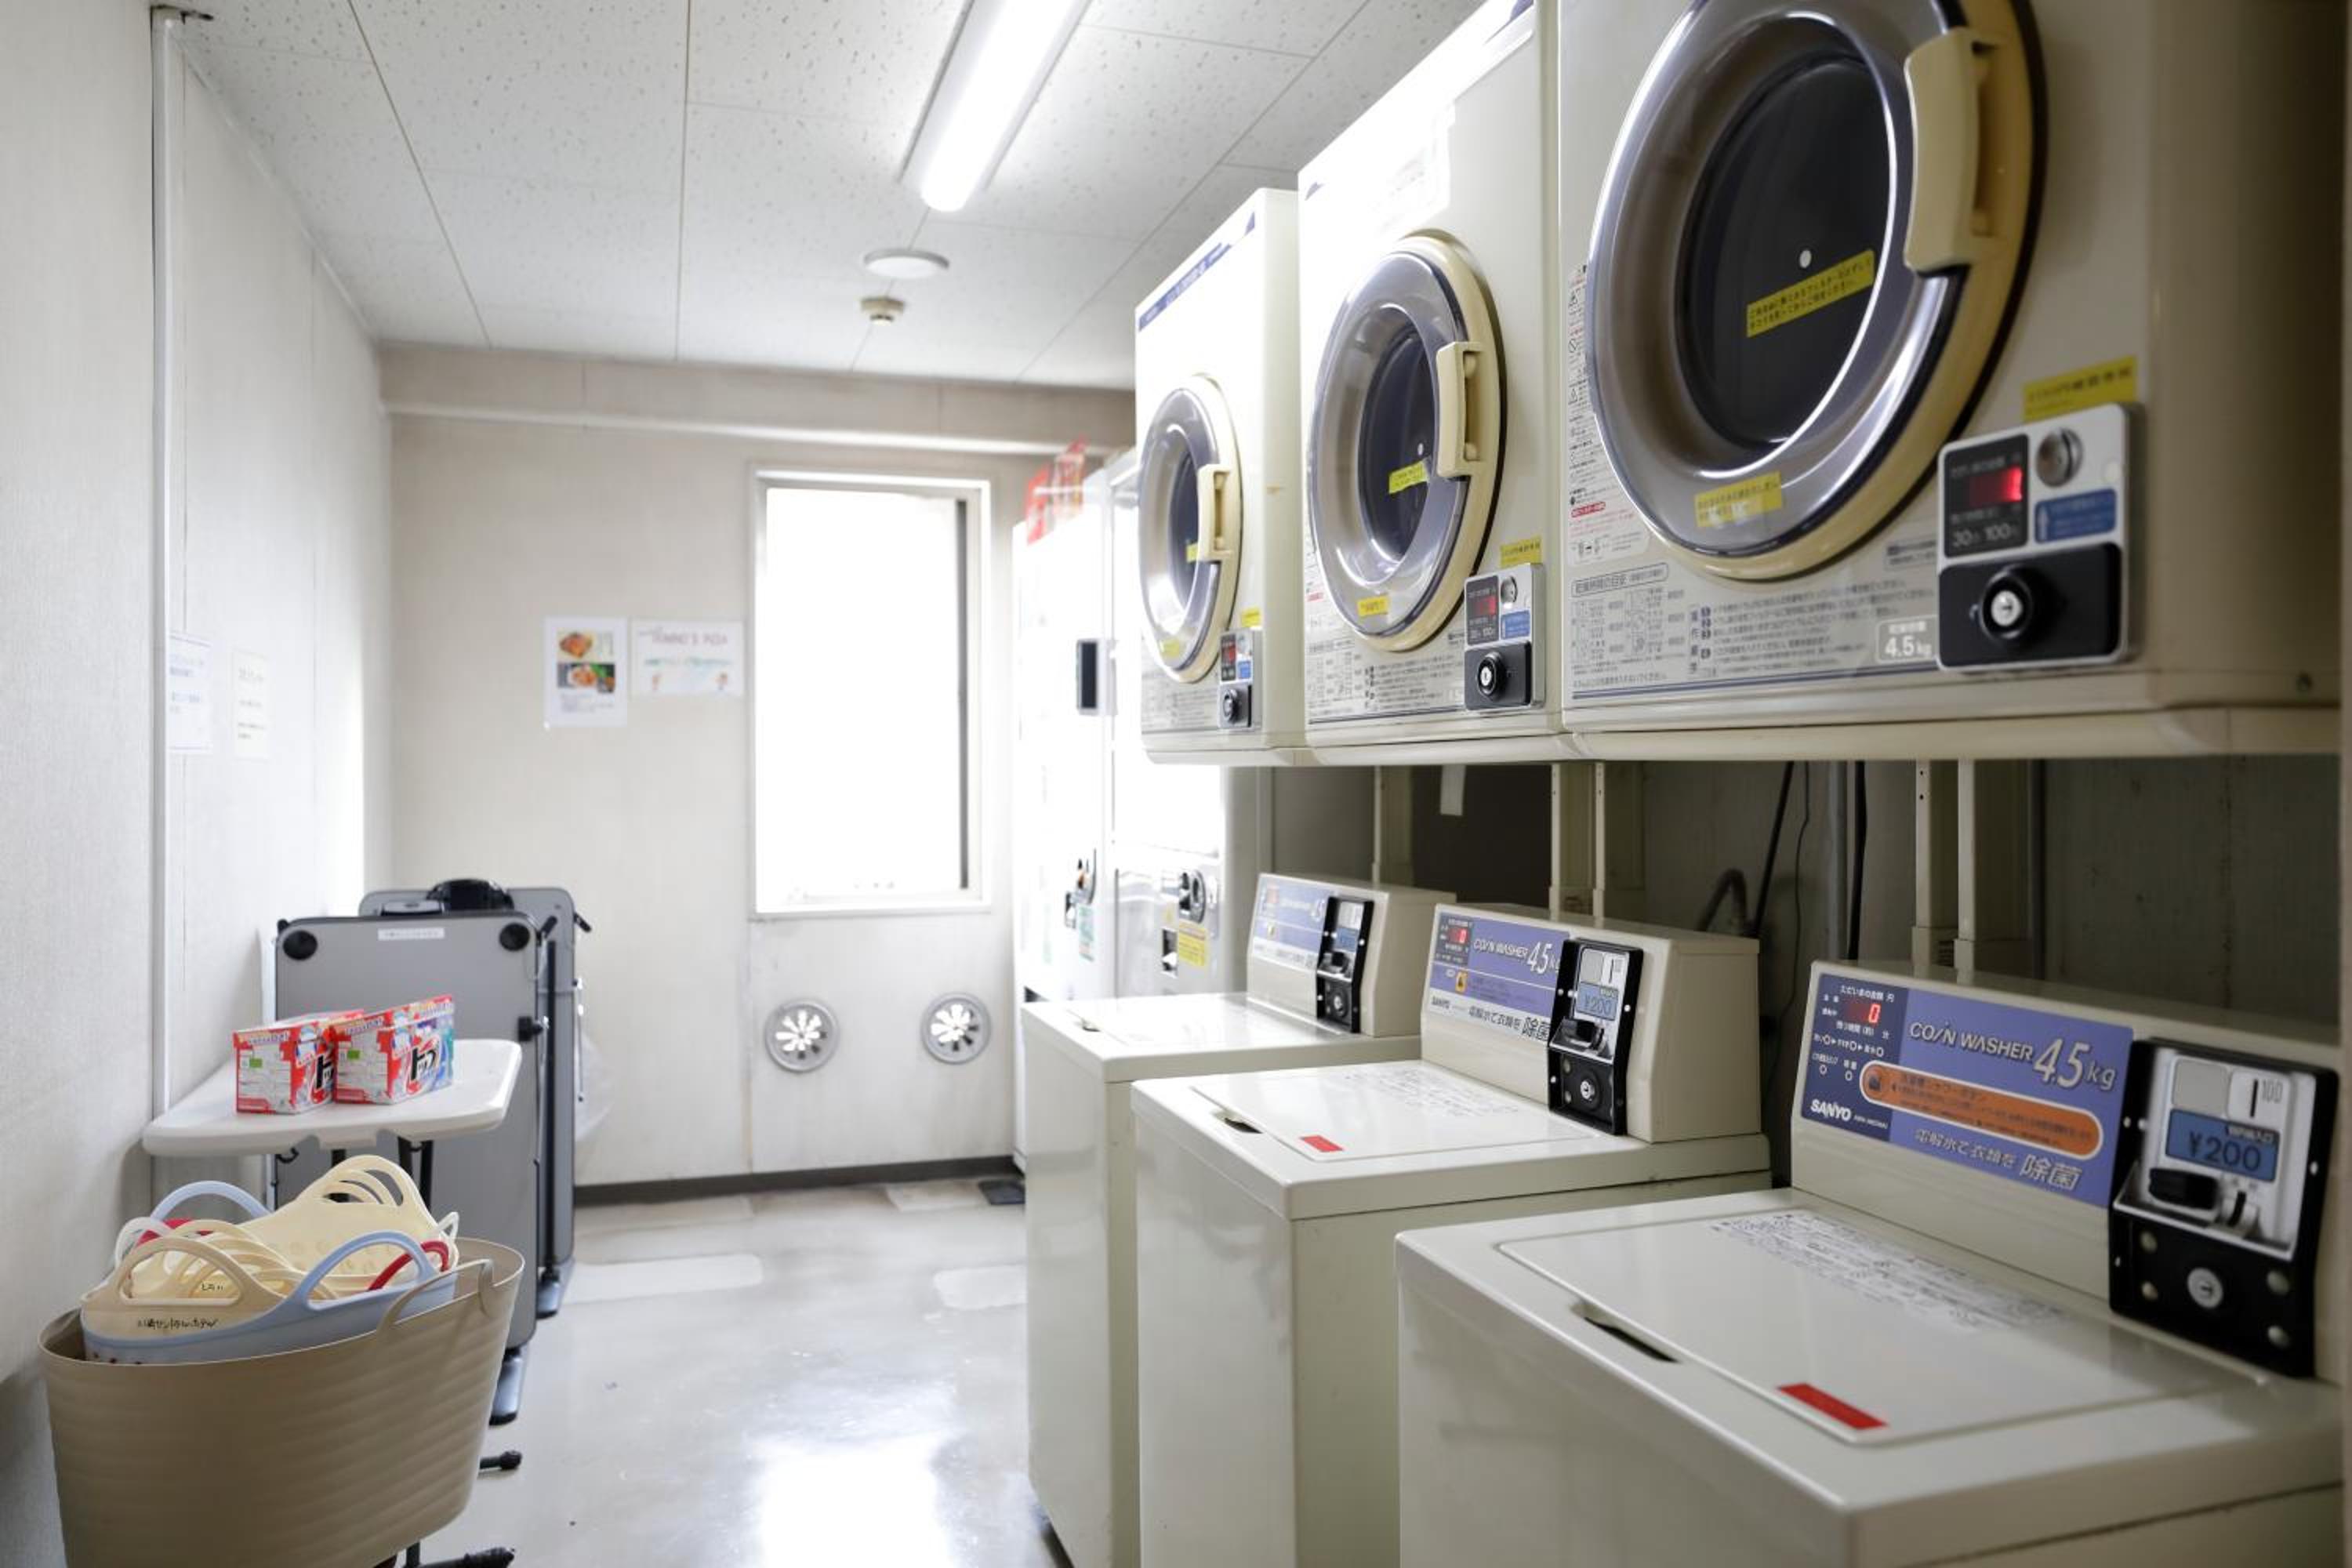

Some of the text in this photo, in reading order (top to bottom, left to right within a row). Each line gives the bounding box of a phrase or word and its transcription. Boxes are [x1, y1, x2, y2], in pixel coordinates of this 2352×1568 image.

[1868, 1003, 1881, 1024] 0
[1910, 1020, 1957, 1045] COIN
[1961, 1032, 2034, 1061] WASHER
[2262, 1078, 2284, 1104] 100
[1810, 1098, 1852, 1123] SANYO
[2189, 1130, 2261, 1172] ¥200
[2019, 1153, 2082, 1192] 除菌
